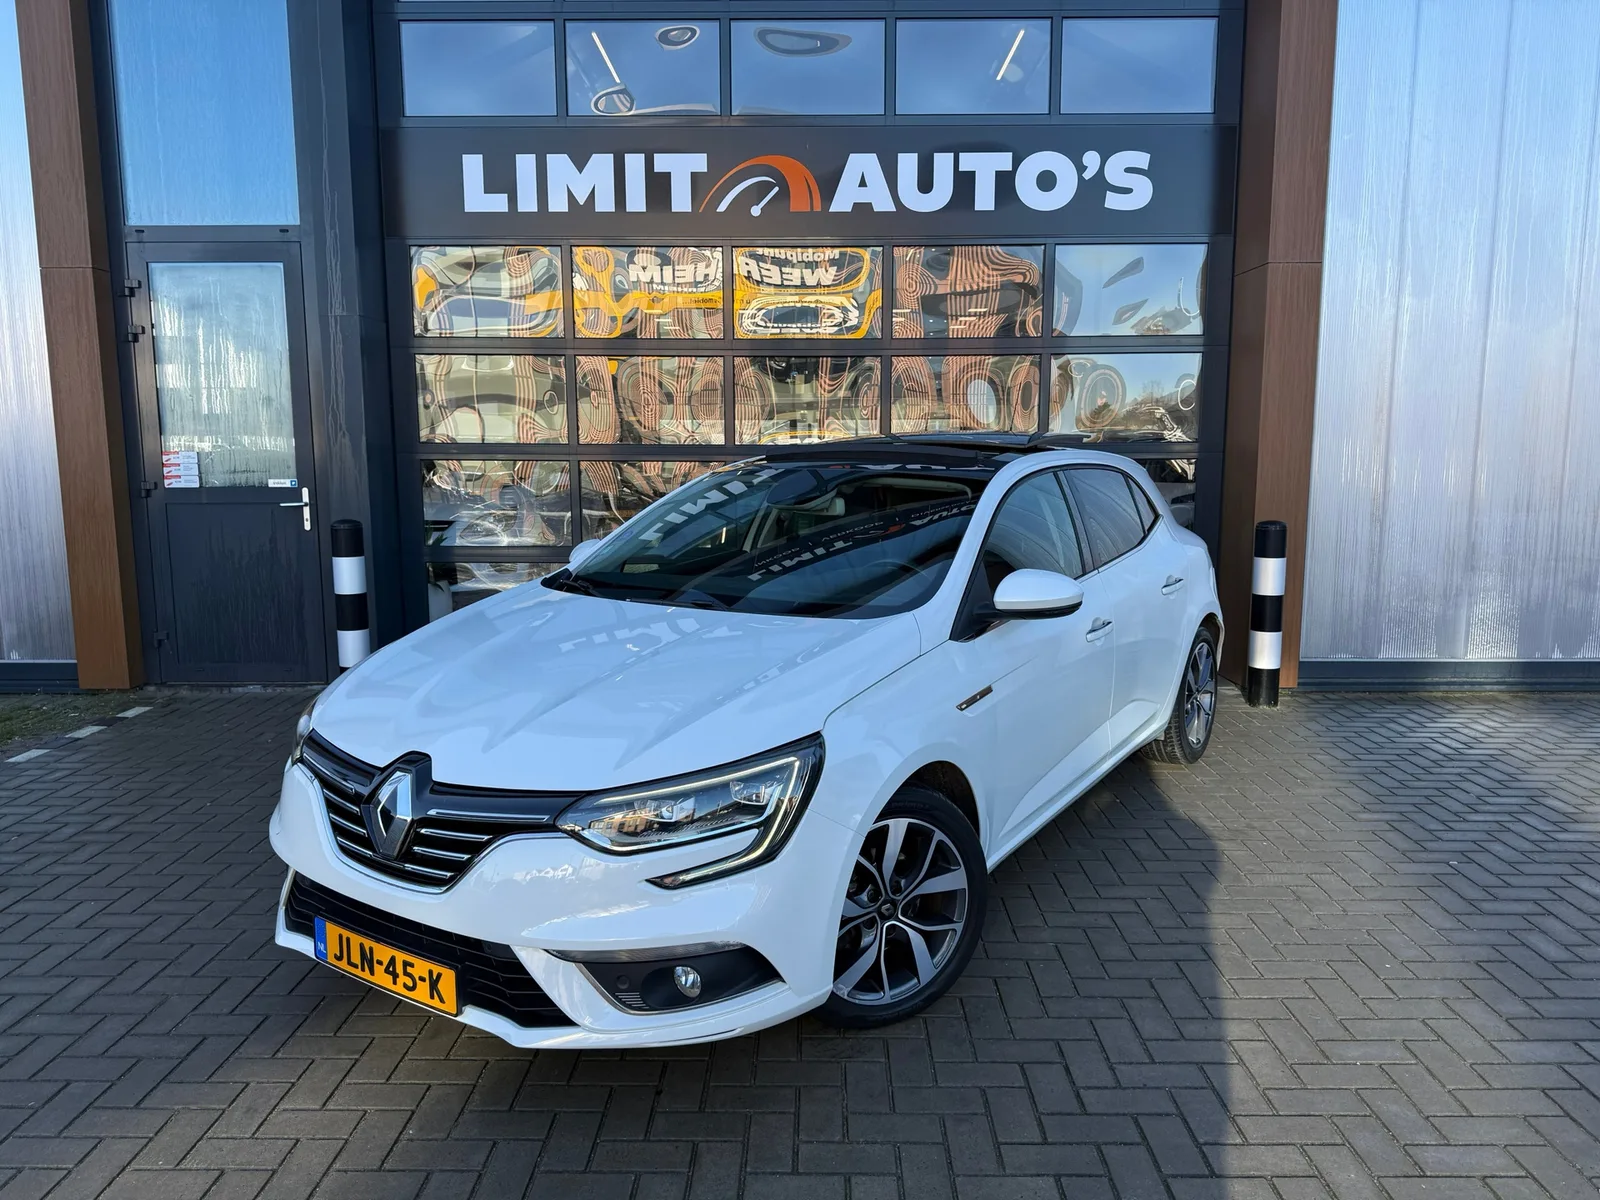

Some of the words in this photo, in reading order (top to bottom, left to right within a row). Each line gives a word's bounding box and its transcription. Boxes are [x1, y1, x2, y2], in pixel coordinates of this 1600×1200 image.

[462, 153, 708, 213] LIMIT
[828, 150, 1154, 213] AUTO’S
[317, 941, 327, 953] NL
[333, 932, 446, 1005] JLN-45-K
